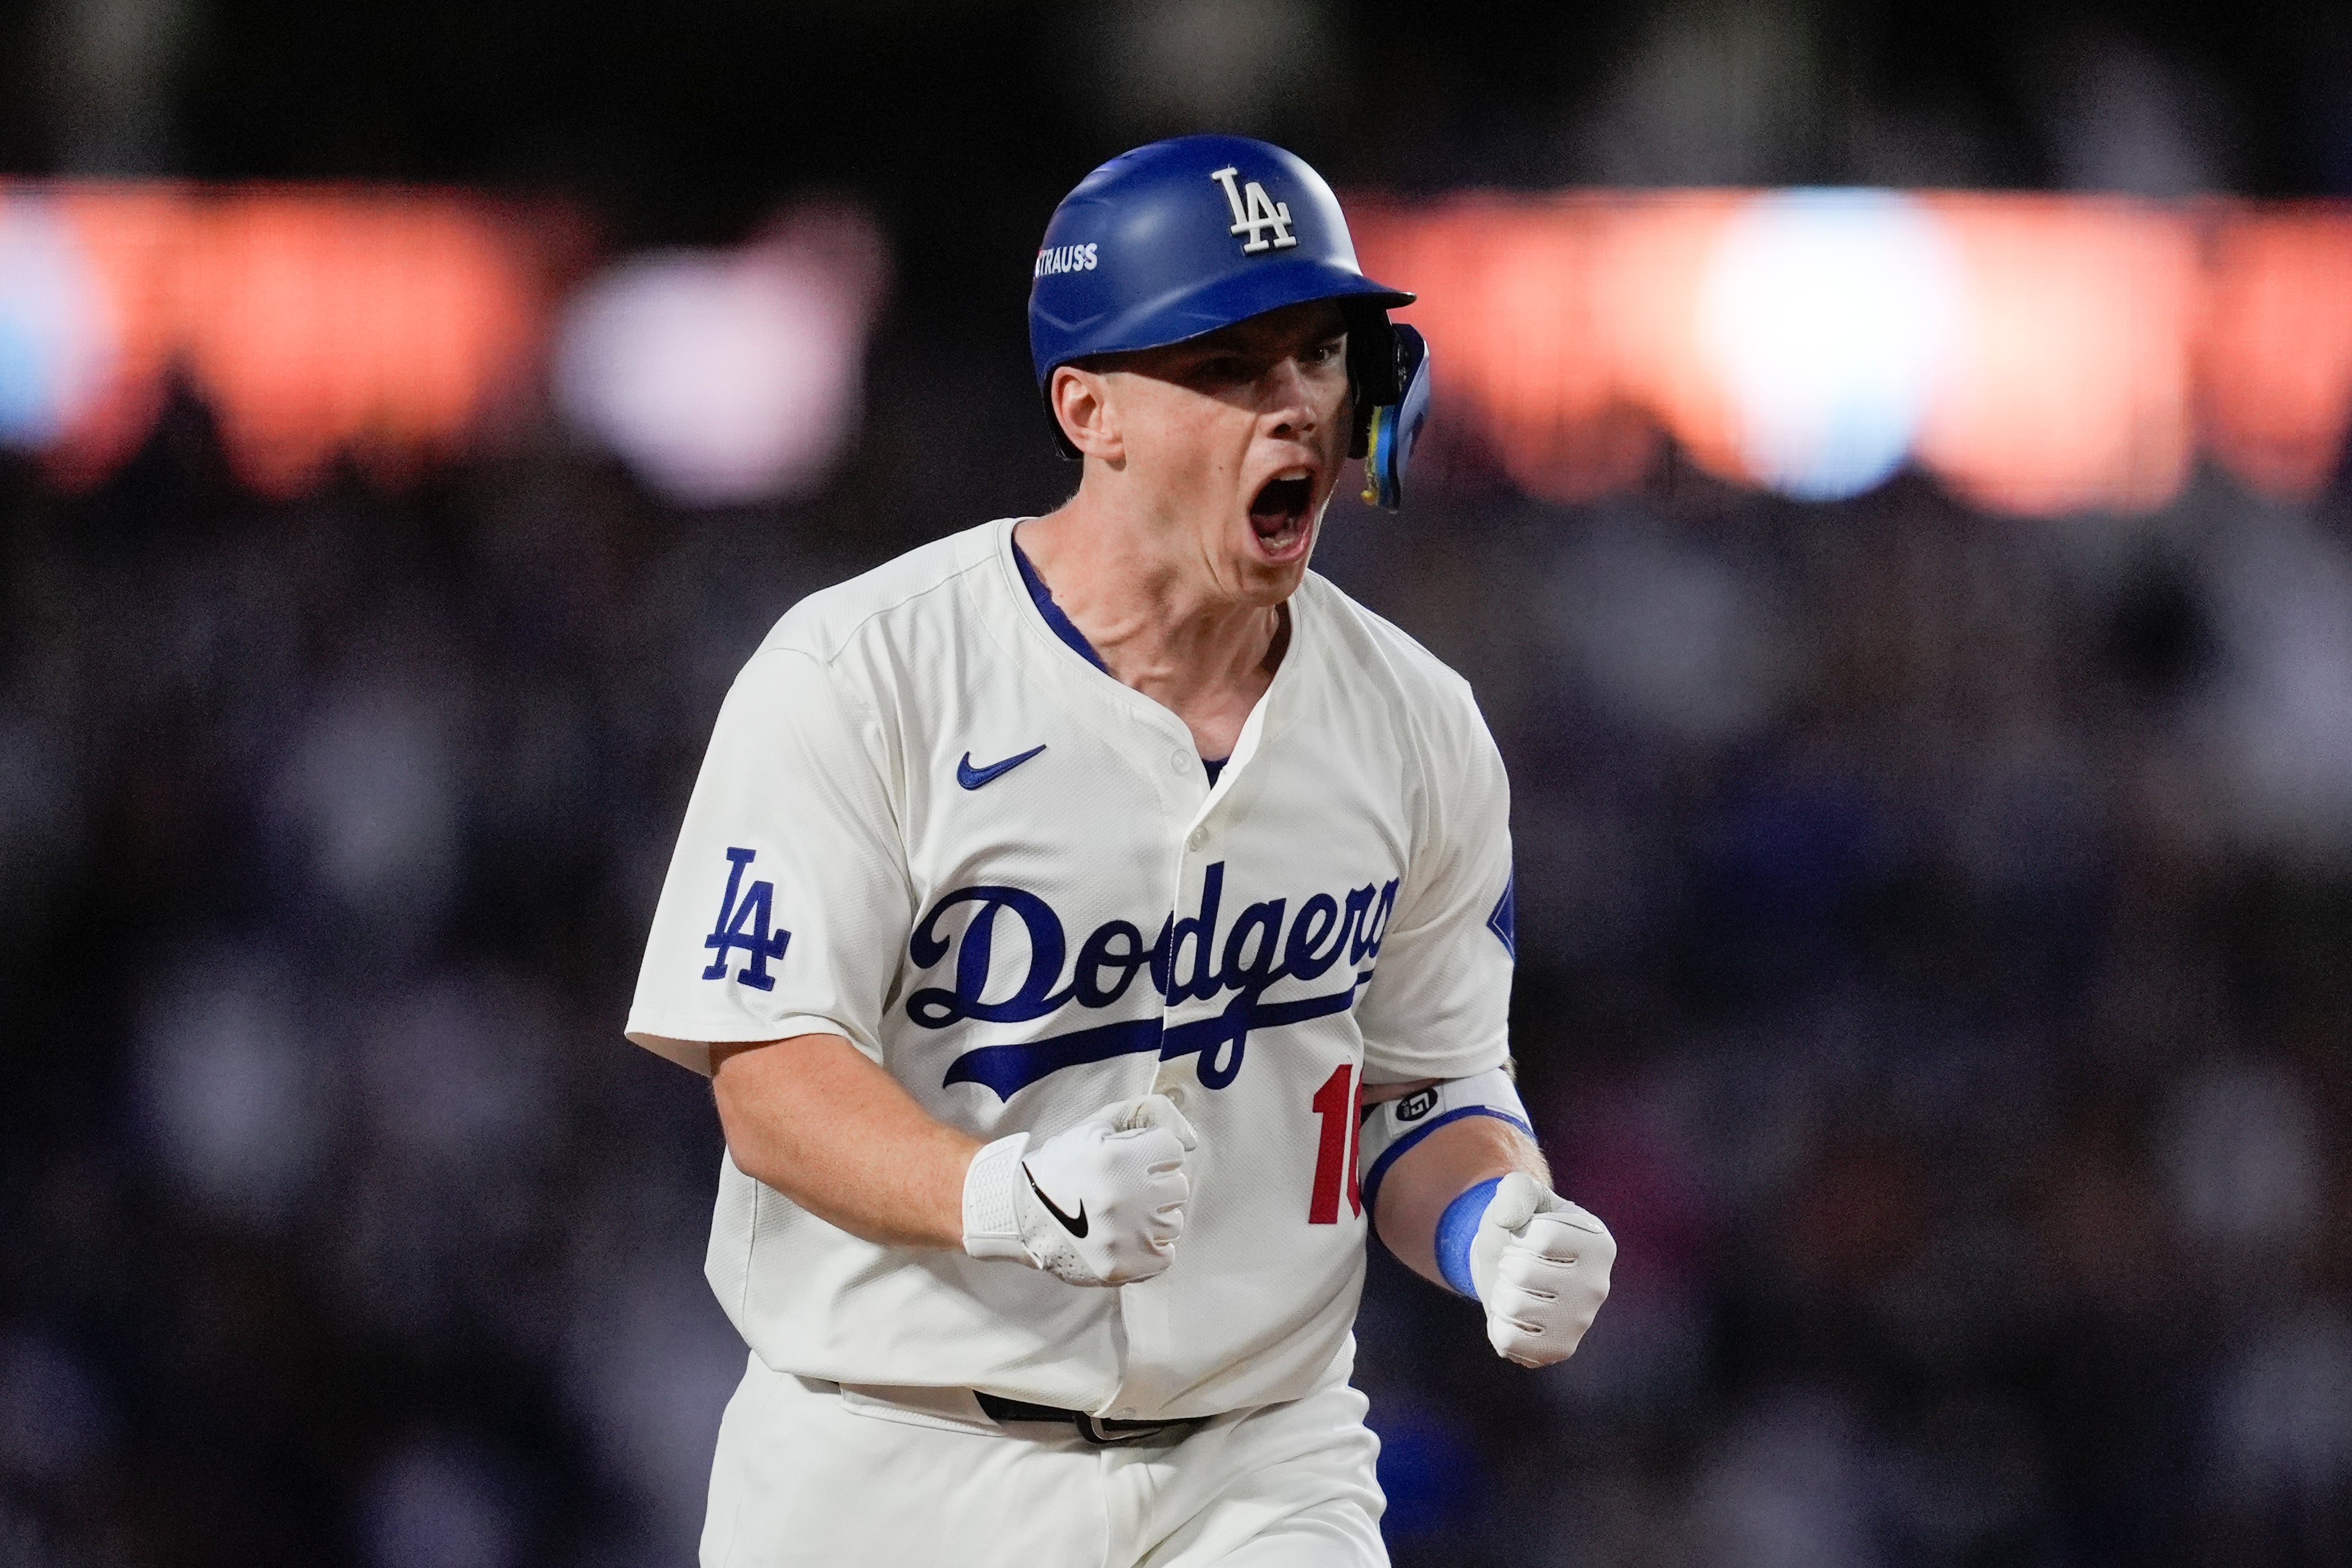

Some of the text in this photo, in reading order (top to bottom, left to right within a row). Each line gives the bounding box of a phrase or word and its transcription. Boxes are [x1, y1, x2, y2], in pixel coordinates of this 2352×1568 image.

[1212, 167, 1297, 252] LA
[702, 847, 792, 992] LA
[906, 861, 1400, 1090] Dodgers
